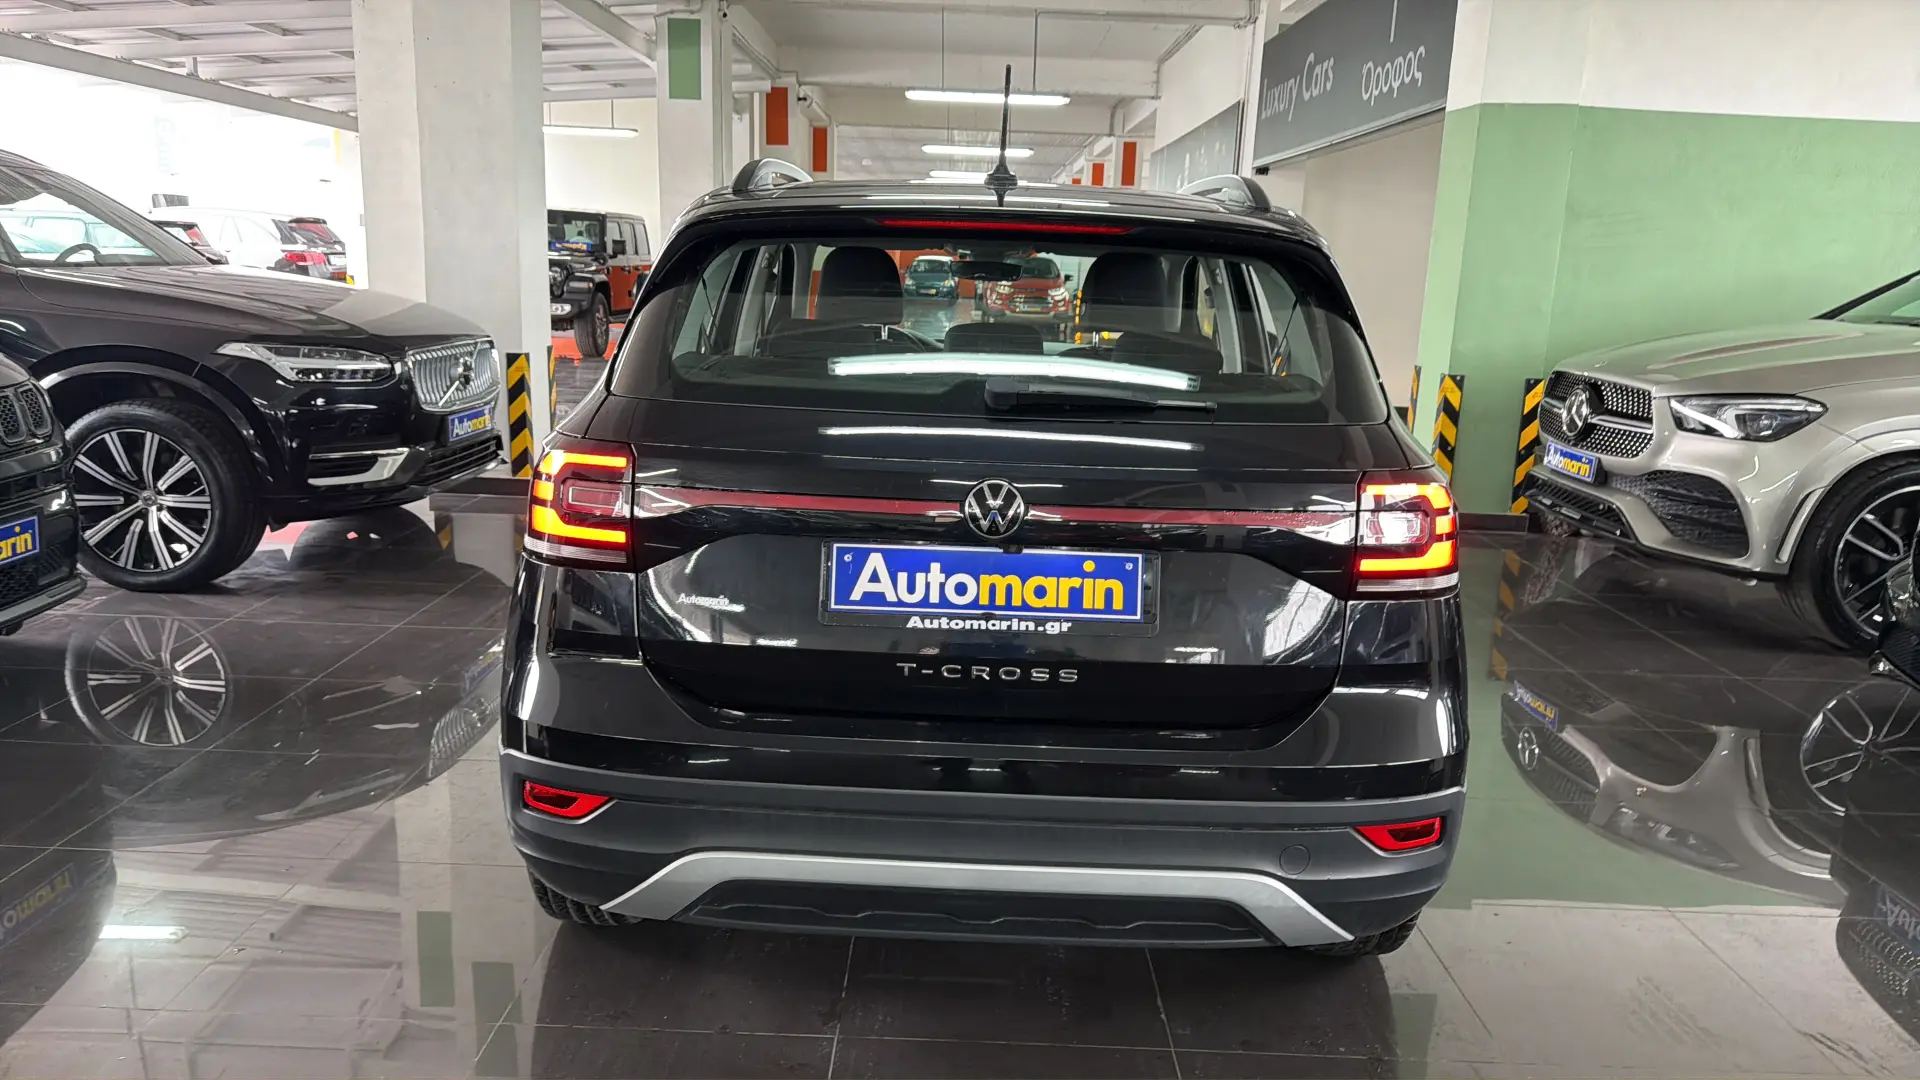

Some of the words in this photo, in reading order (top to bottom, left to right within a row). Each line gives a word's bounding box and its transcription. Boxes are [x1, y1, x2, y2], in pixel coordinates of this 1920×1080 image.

[1261, 75, 1300, 122] Luxury
[1302, 52, 1335, 101] Cars
[1547, 444, 1590, 477] Automarin
[849, 552, 1124, 610] Automarin
[676, 593, 729, 606] Automarin
[906, 615, 1072, 634] Automarin.gr
[896, 663, 1078, 682] T-CROSS
